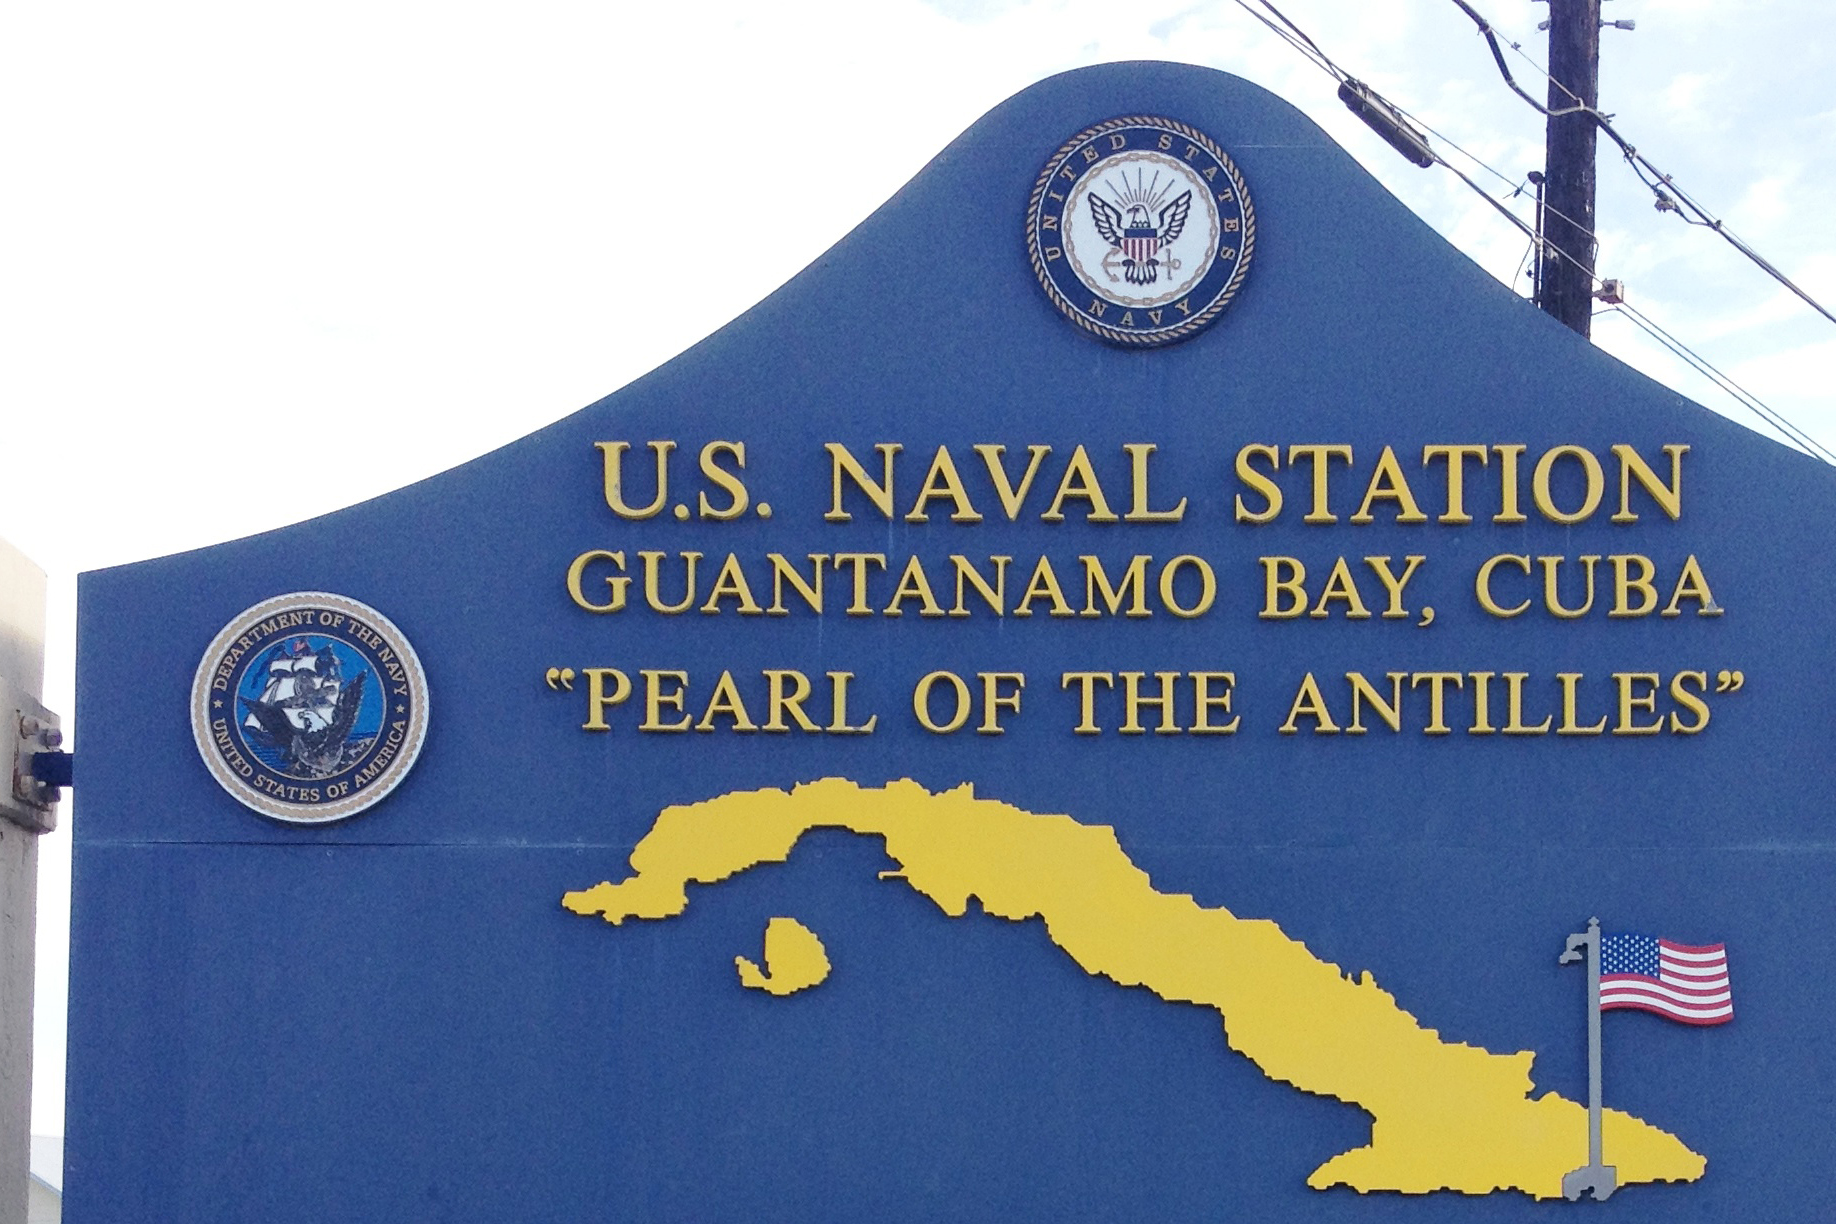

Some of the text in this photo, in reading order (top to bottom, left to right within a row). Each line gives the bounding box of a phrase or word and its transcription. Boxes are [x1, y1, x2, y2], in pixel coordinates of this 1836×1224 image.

[1042, 133, 1240, 262] UNITED STATES
[1088, 298, 1192, 327] NAVY
[594, 440, 1690, 524] U.S. NAVAL STATION
[566, 550, 1725, 628] GUANTANAMO BAY, CUBA
[213, 610, 408, 697] DEPARTMENT OF THE NAVY
[913, 670, 1026, 734] OF
[1062, 671, 1242, 734] THE
[212, 717, 407, 802] UNITED STATES OF AMERICA
